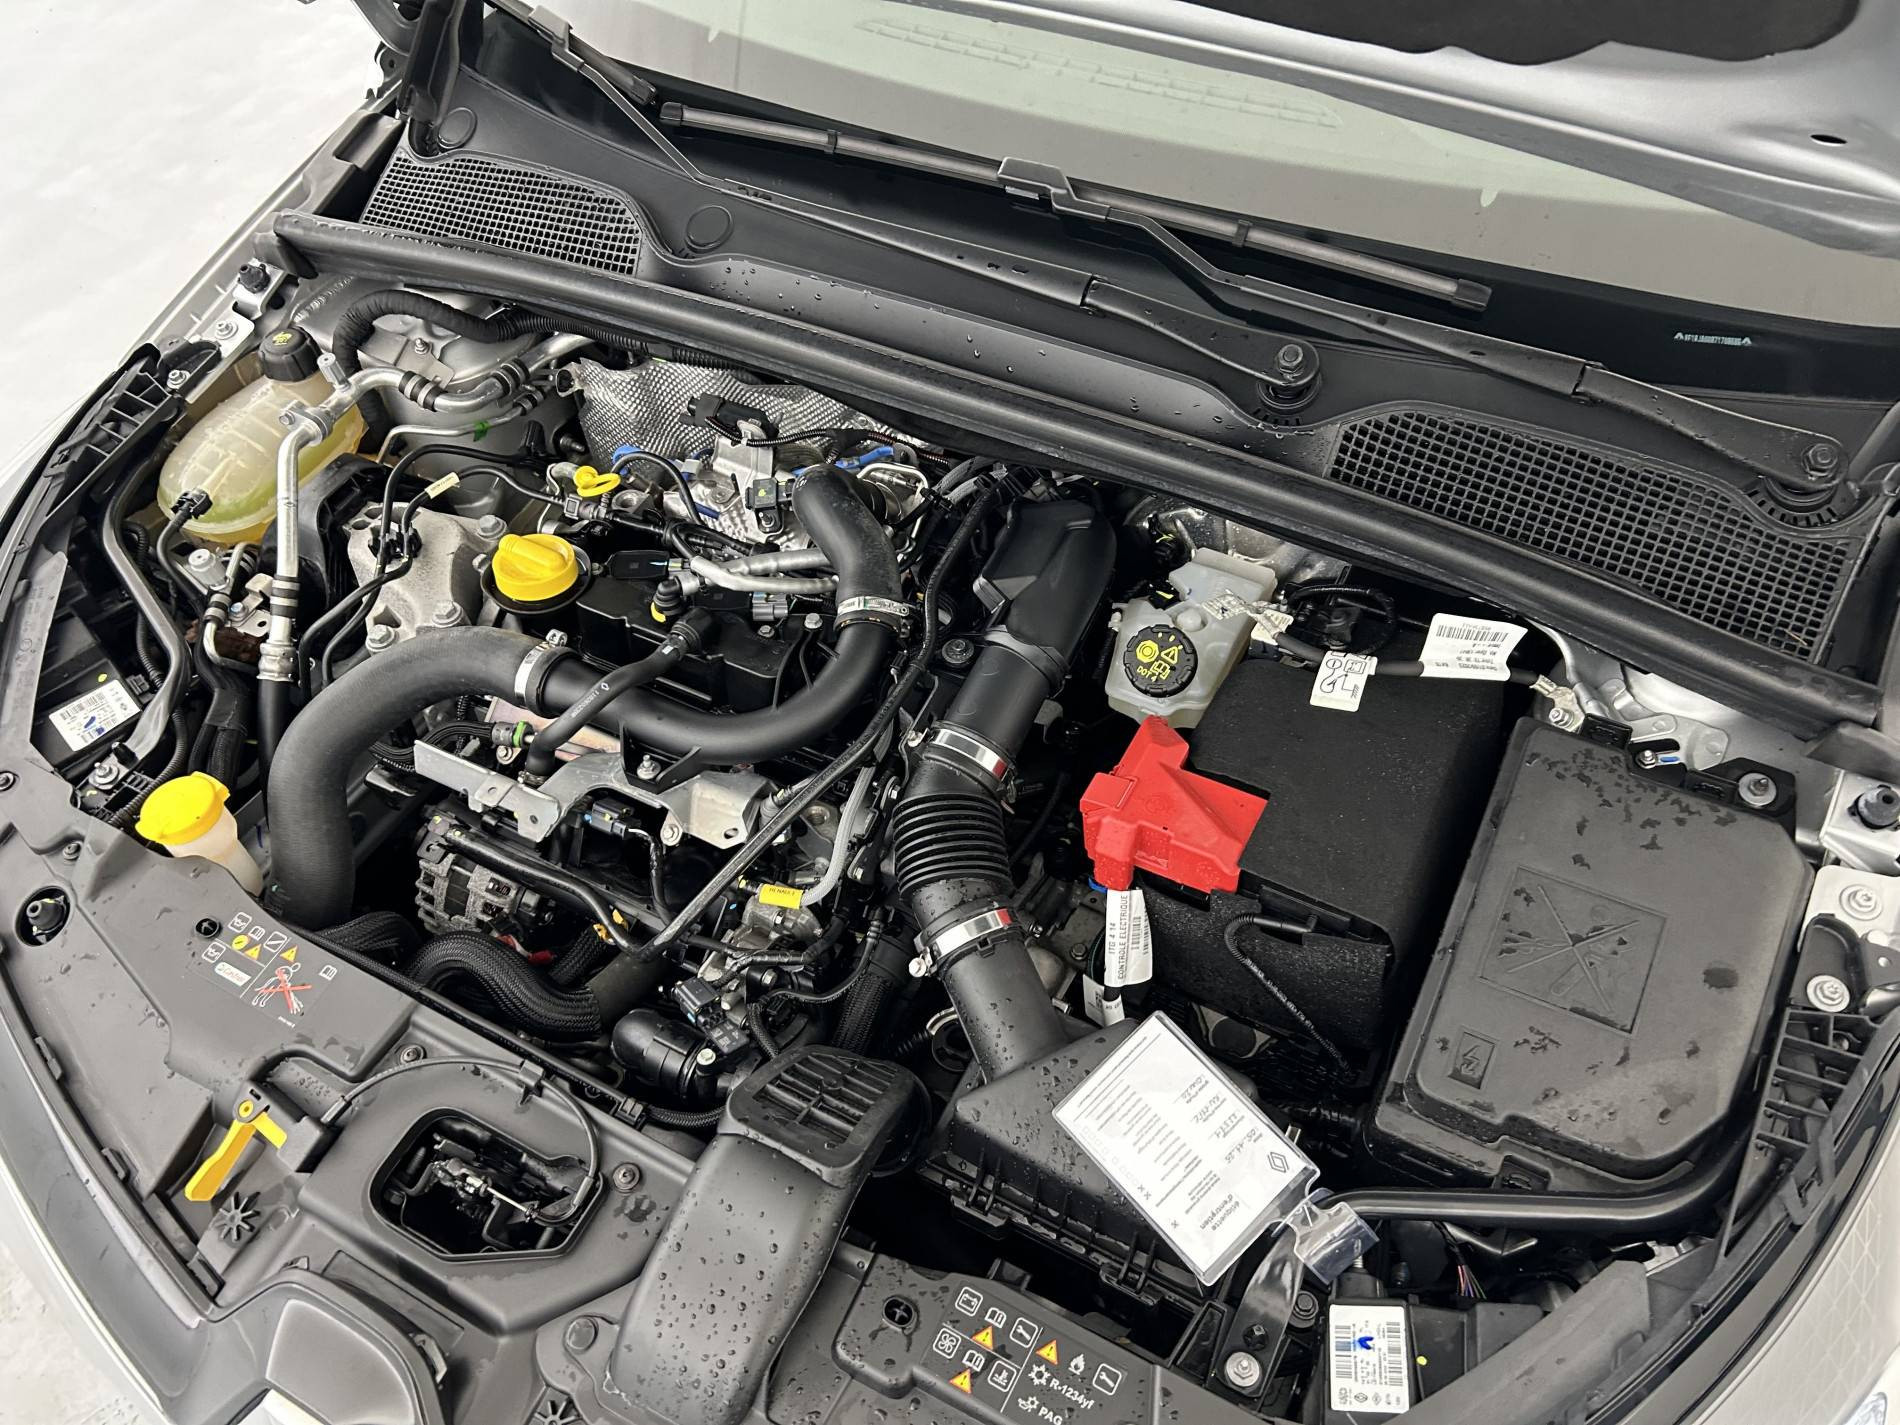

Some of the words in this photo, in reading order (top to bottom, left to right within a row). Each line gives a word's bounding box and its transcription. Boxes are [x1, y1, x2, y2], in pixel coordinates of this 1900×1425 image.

[1137, 665, 1152, 678] DOT
[1119, 895, 1128, 940] ELECTRIQUE
[1210, 1201, 1240, 1231] étiquette
[1049, 1378, 1095, 1409] R-1234yf
[1038, 1406, 1063, 1425] PAG
